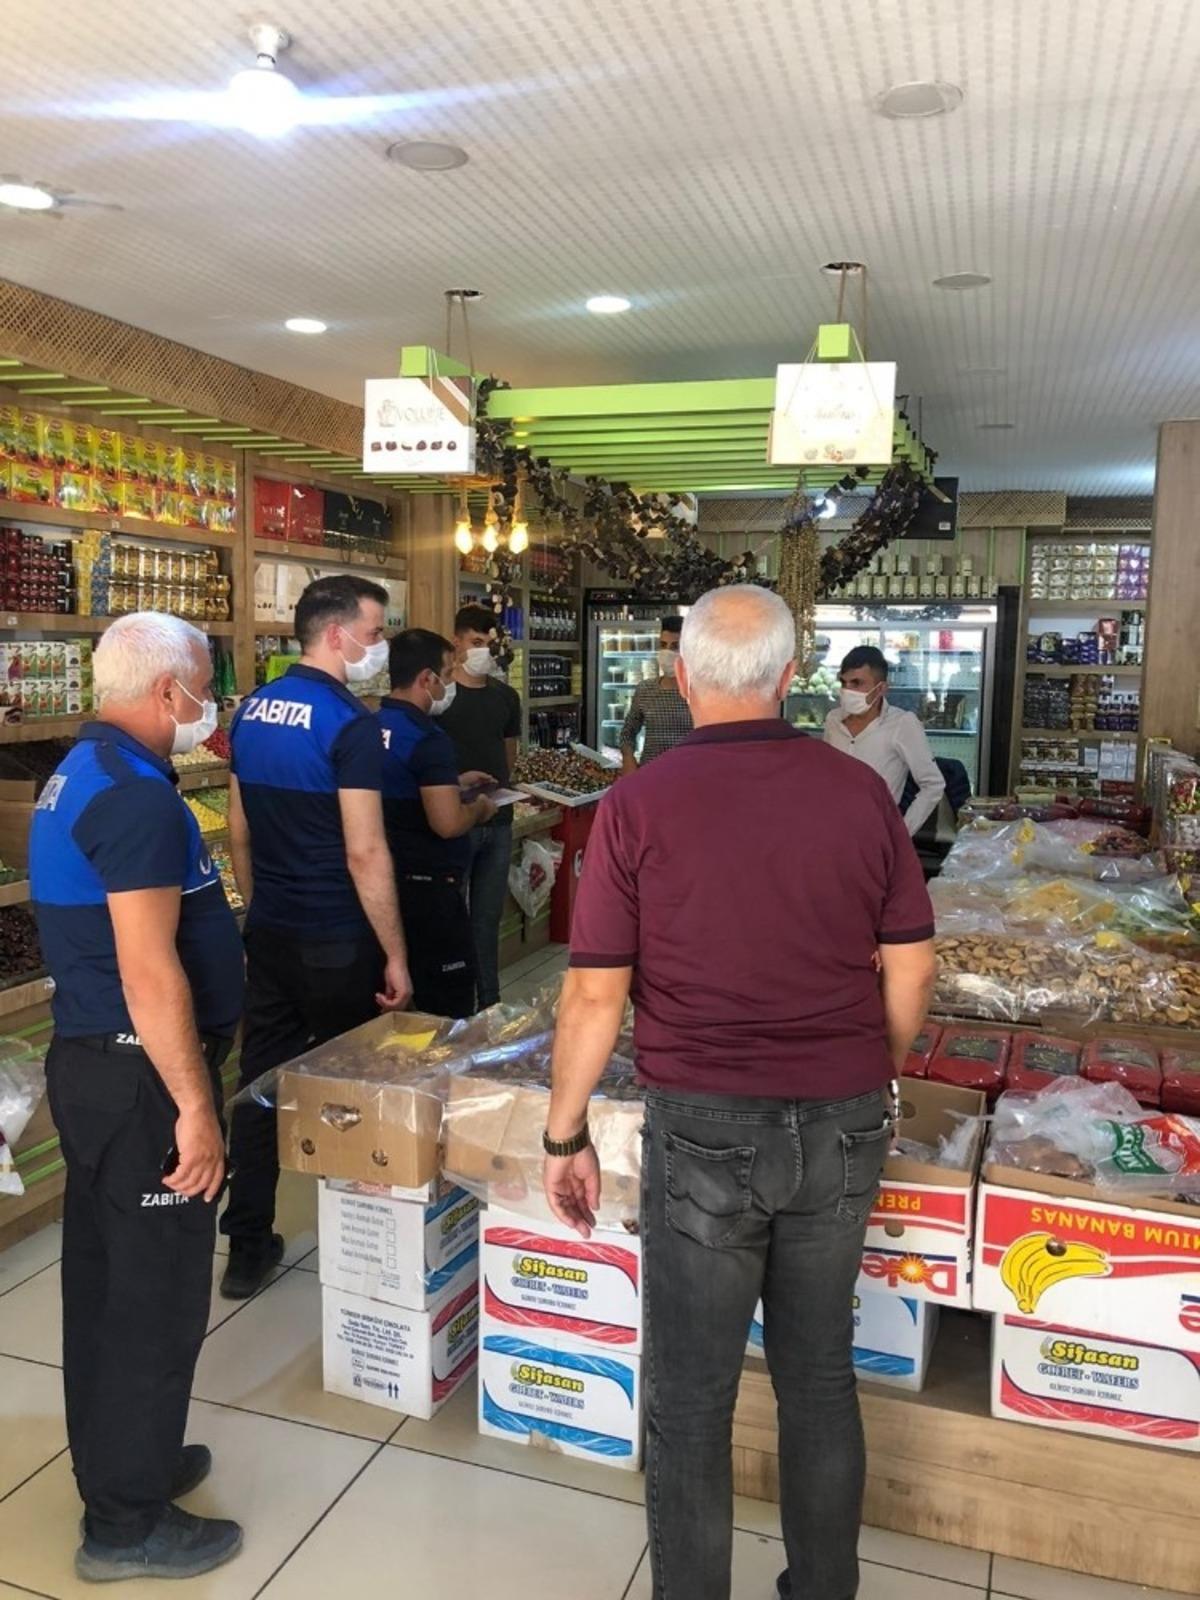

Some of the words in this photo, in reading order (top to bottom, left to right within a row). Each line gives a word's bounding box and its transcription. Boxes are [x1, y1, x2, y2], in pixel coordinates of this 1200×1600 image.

[242, 697, 313, 731] ZABITA
[140, 1192, 190, 1207] ZABITA
[1031, 1207, 1136, 1240] BANANAS
[520, 1256, 589, 1284] Sifasan
[860, 1253, 958, 1297] Dole
[1050, 1340, 1139, 1371] Sifasan
[518, 1364, 585, 1393] Sifasan
